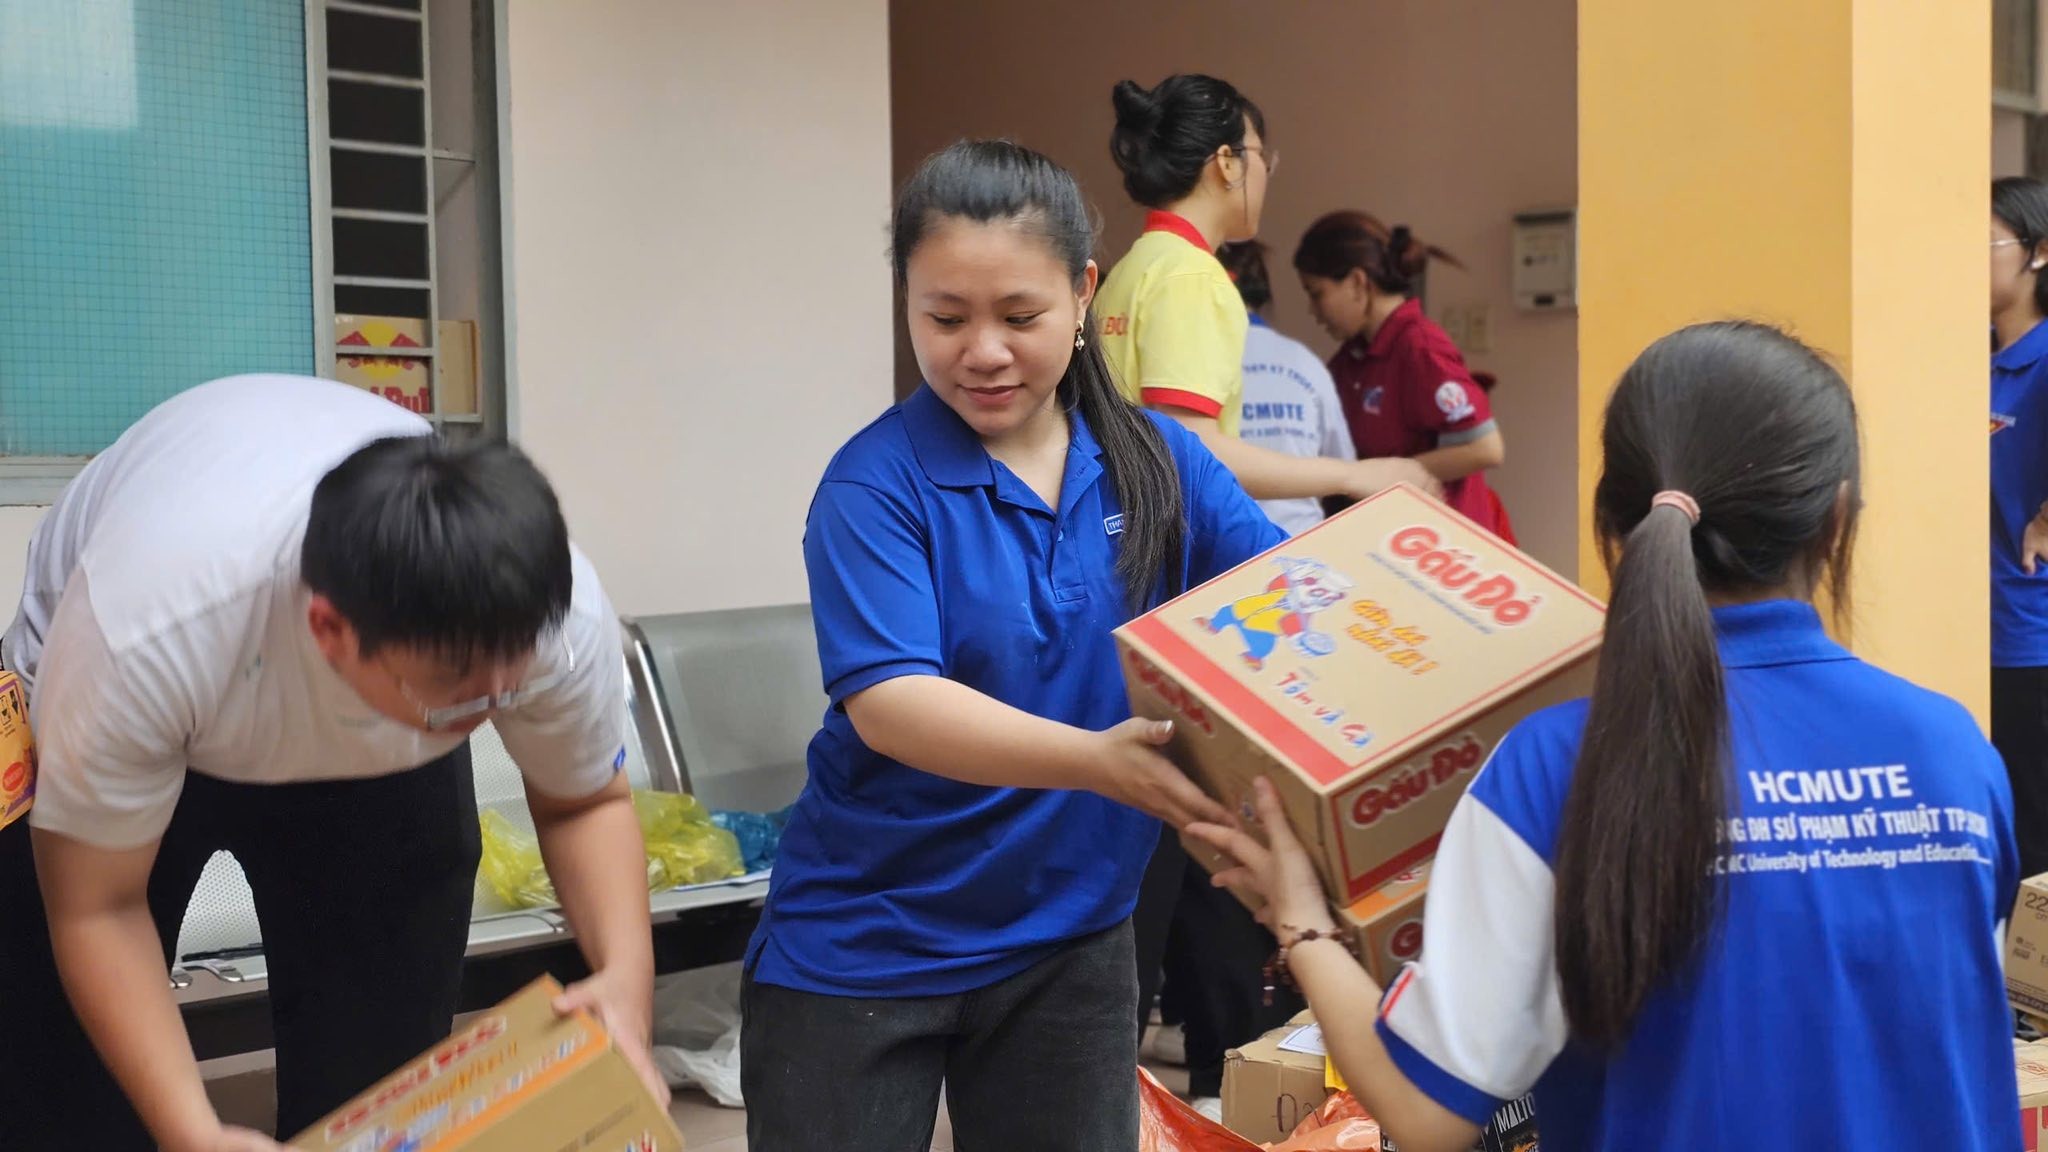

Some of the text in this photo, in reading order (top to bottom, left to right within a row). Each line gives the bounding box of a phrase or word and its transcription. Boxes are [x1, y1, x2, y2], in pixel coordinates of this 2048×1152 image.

[1242, 403, 1304, 421] CMUTE
[1748, 764, 1913, 804] HCMUTE
[1798, 814, 1850, 845] PHẠM
[1851, 807, 1878, 838] KỸ
[1880, 803, 1941, 839] THUẬT
[1747, 852, 1807, 874] University
[1808, 849, 1822, 868] of
[1822, 846, 1897, 870] Technology
[1898, 843, 1923, 863] and
[1496, 1091, 1536, 1134] MALTO
